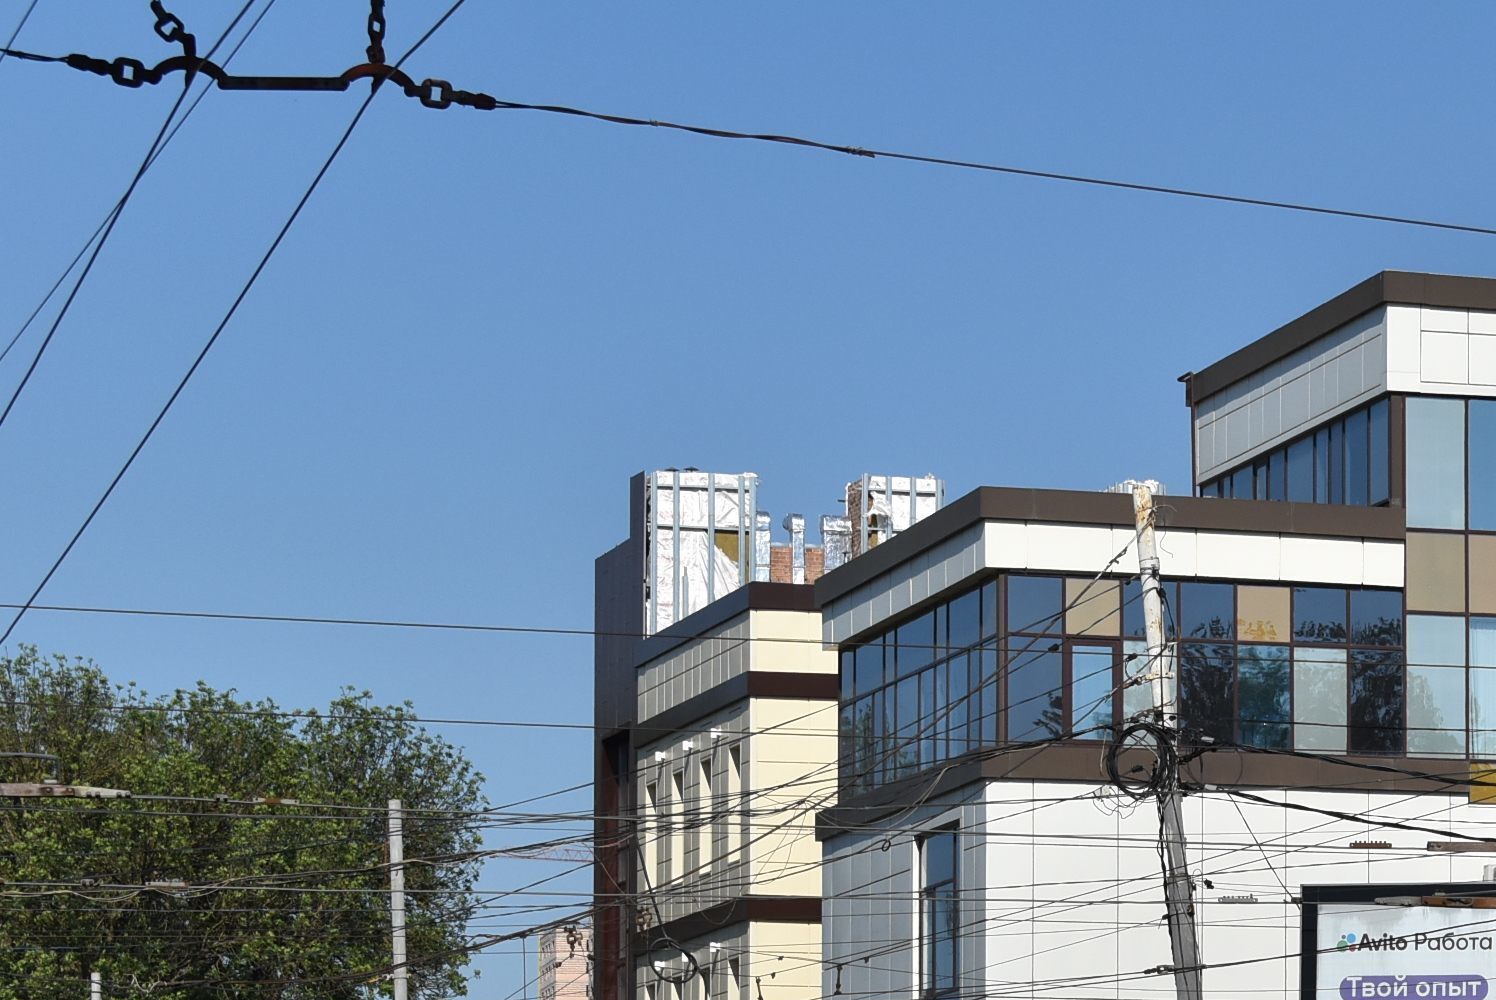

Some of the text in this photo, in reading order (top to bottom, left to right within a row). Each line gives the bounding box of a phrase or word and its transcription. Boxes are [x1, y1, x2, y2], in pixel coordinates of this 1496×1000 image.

[1358, 932, 1493, 951] Avito Работа
[1346, 974, 1482, 998] Твой опыт
